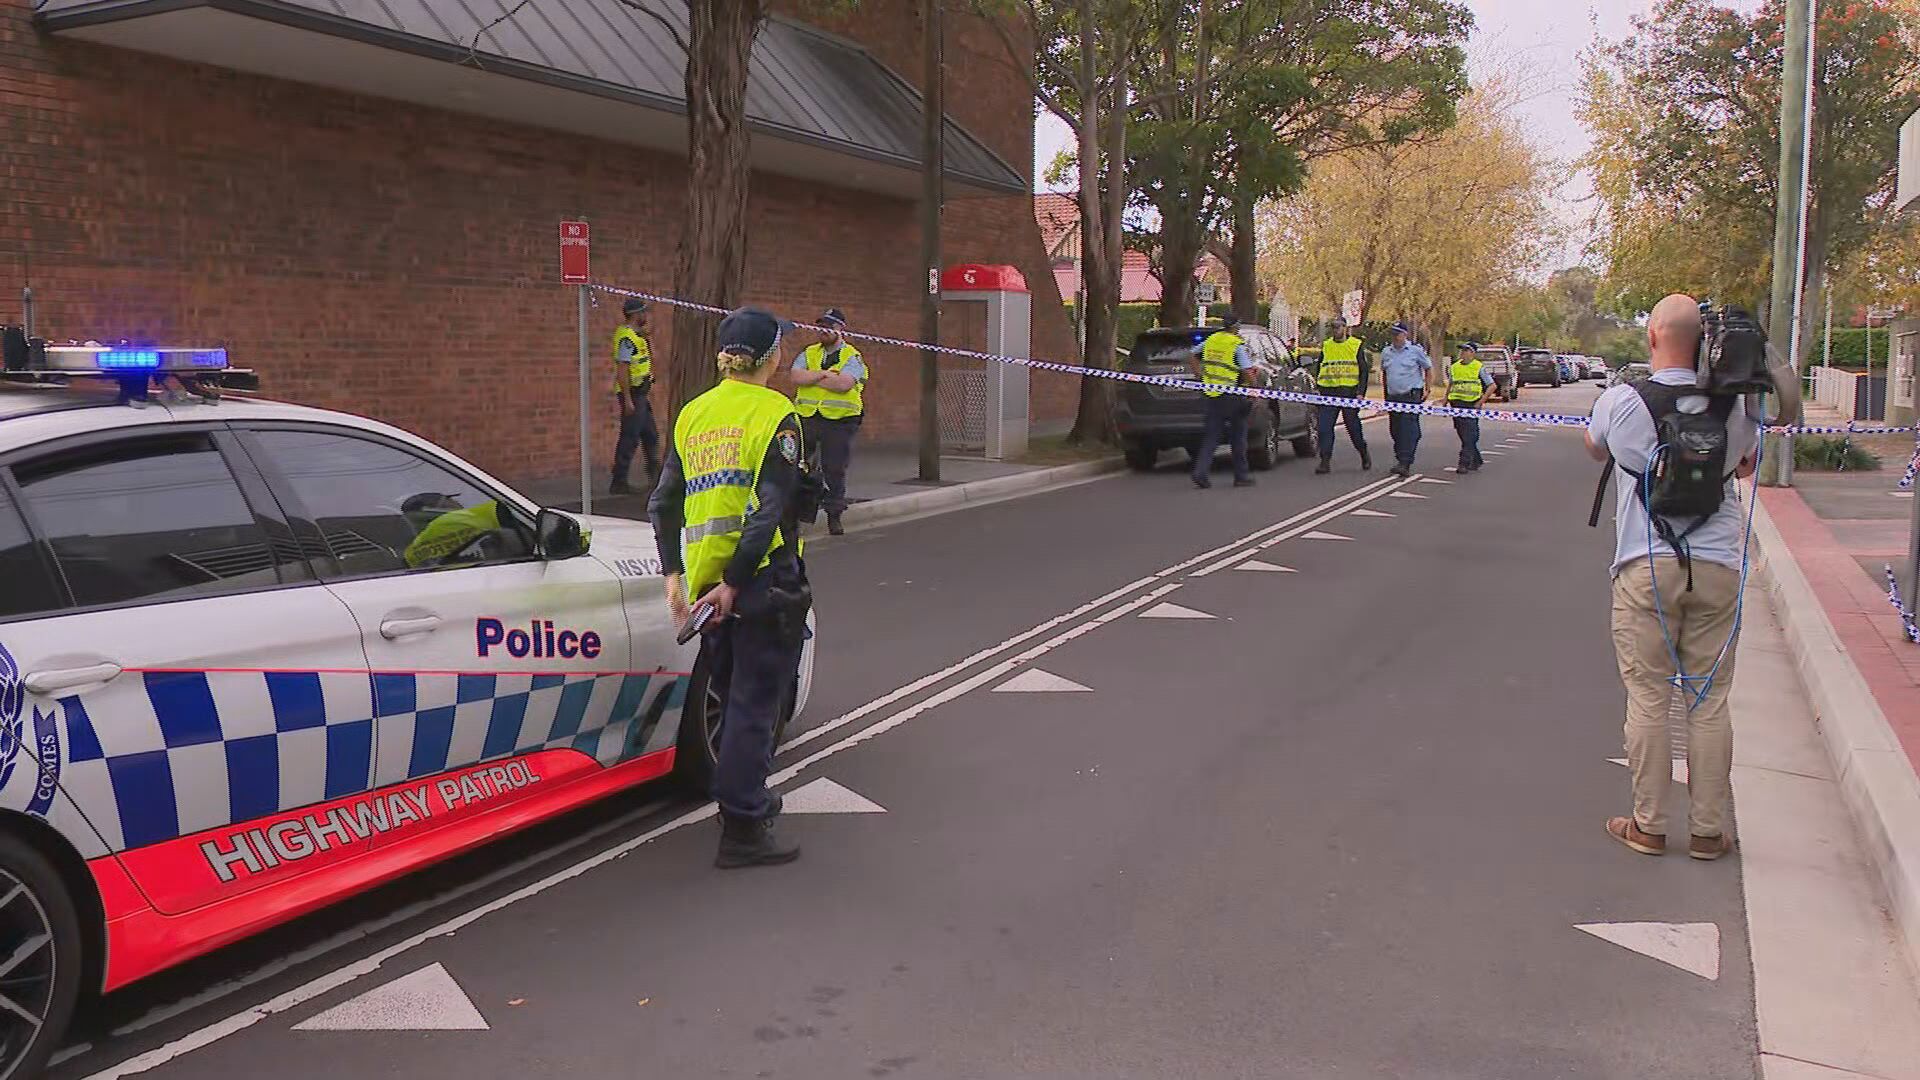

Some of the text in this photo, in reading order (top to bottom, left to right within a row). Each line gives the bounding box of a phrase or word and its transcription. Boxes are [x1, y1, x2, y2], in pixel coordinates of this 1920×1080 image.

[568, 225, 580, 236] NO
[476, 617, 602, 659] Police
[37, 734, 57, 801] COMES
[199, 758, 542, 883] HIGHWAY PATROL
